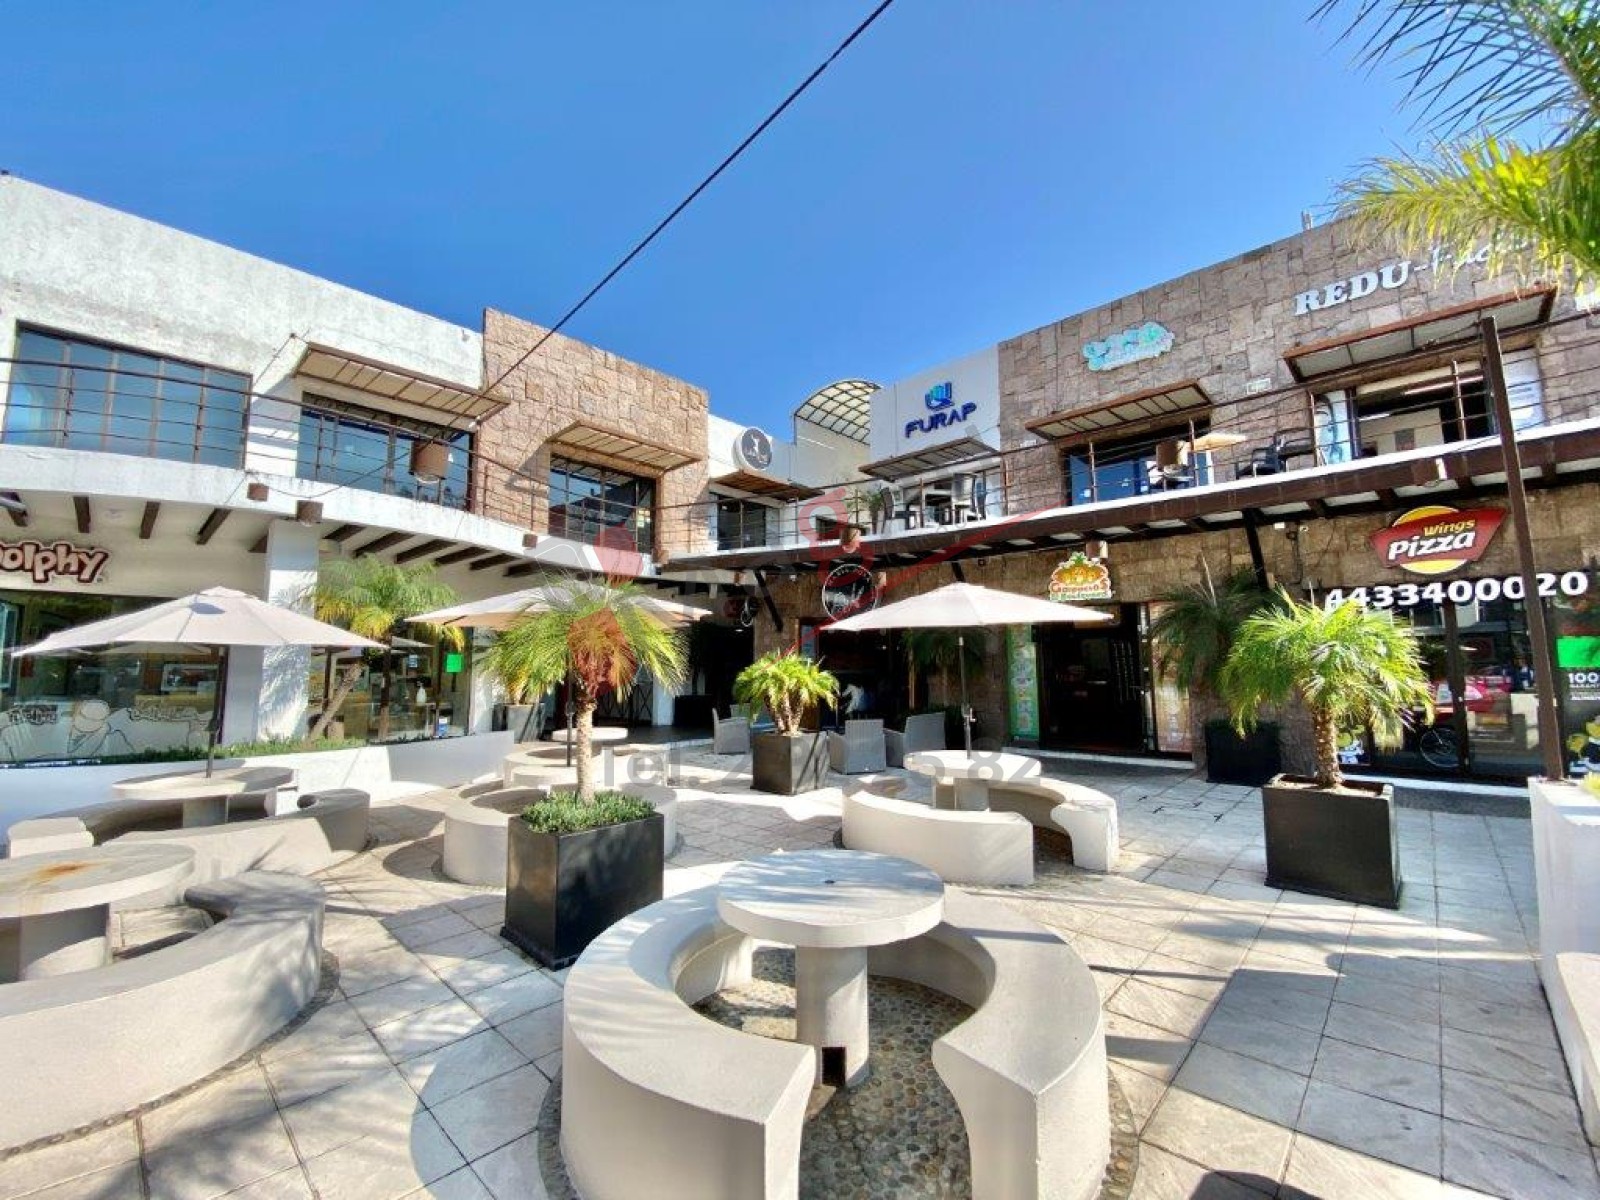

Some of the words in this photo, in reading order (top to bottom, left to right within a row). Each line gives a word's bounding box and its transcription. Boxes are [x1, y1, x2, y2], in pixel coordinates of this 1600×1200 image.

[904, 402, 978, 439] FURAP
[0, 542, 109, 584] olphy
[1388, 531, 1476, 560] Pizza
